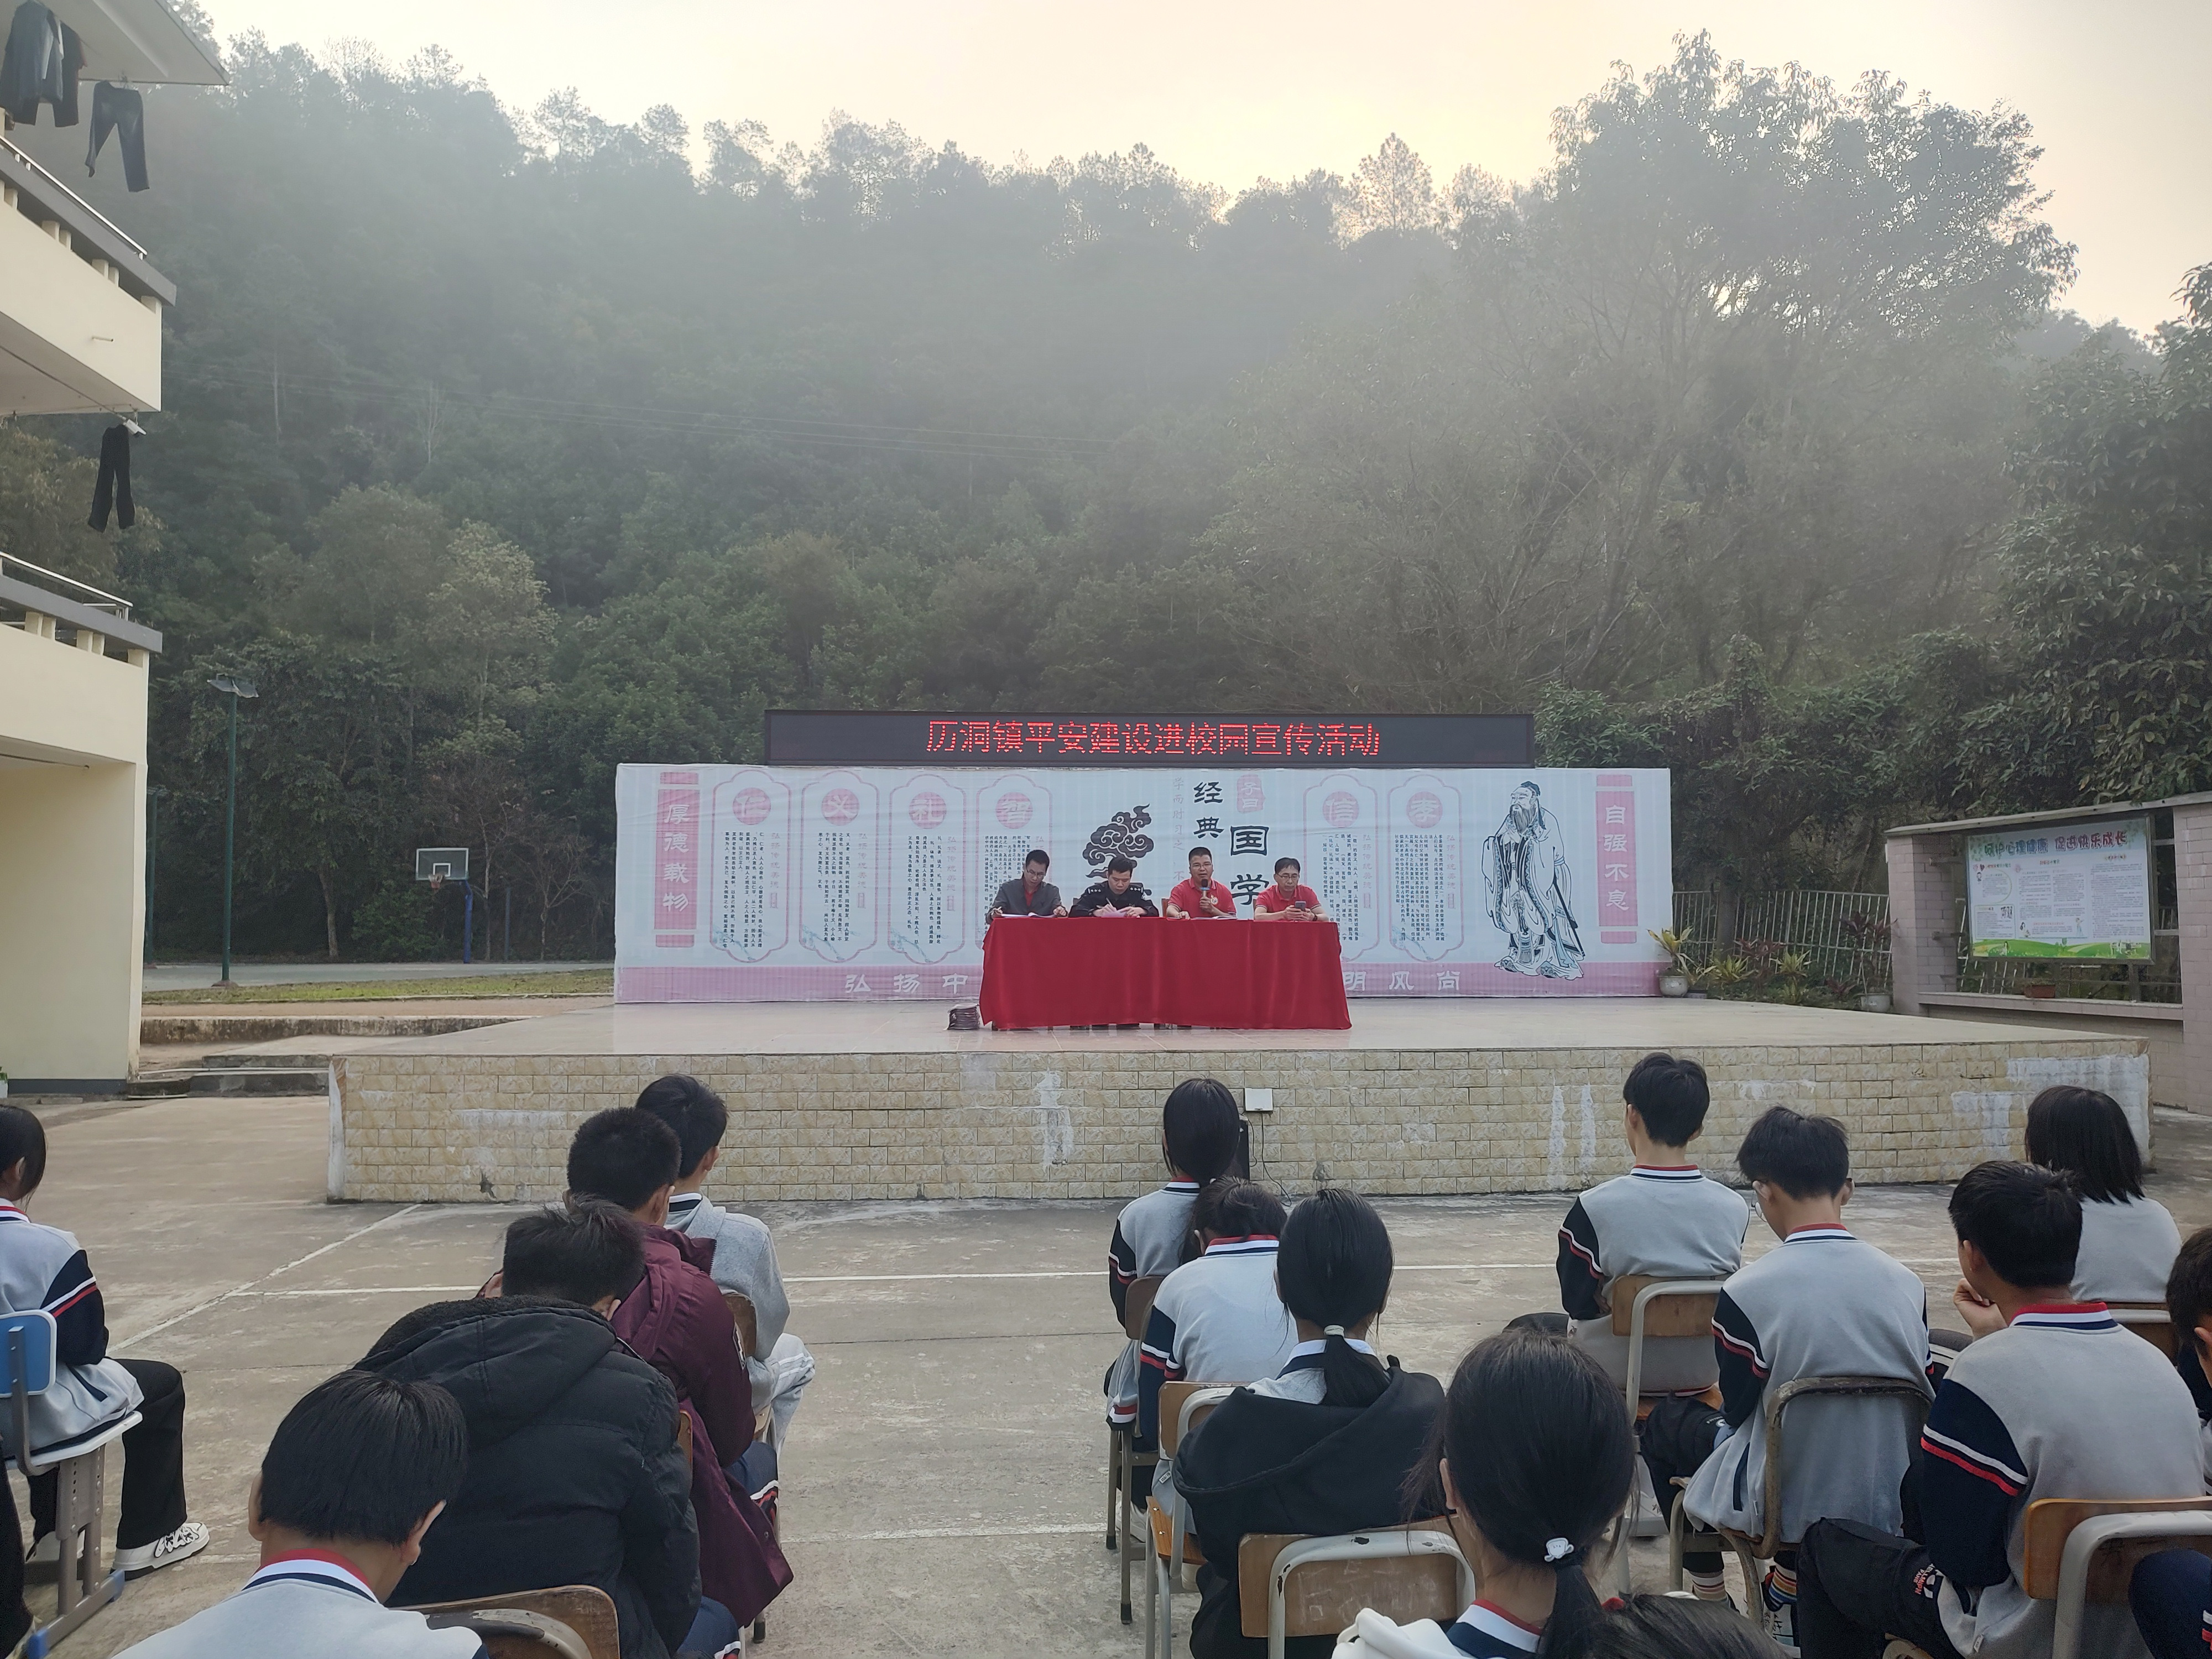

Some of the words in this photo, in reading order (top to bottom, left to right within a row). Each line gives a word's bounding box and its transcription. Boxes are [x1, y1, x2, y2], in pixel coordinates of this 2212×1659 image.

[926, 720, 1380, 756] 历洞镇平安建设进校园宣传活动
[733, 795, 768, 817] 仁
[823, 794, 857, 819] 义
[1241, 782, 1260, 808] 子曰
[911, 799, 943, 822] 礼
[1001, 800, 1031, 823] 智
[1194, 781, 1224, 839] 经典
[1326, 798, 1357, 822] 信
[1410, 798, 1438, 823] 孝
[2054, 830, 2128, 851] 促进快乐成长
[663, 804, 690, 913] 厚德载物
[1230, 825, 1270, 905] 国学
[1603, 804, 1630, 911] 自强不息
[845, 972, 968, 994] 弘扬中
